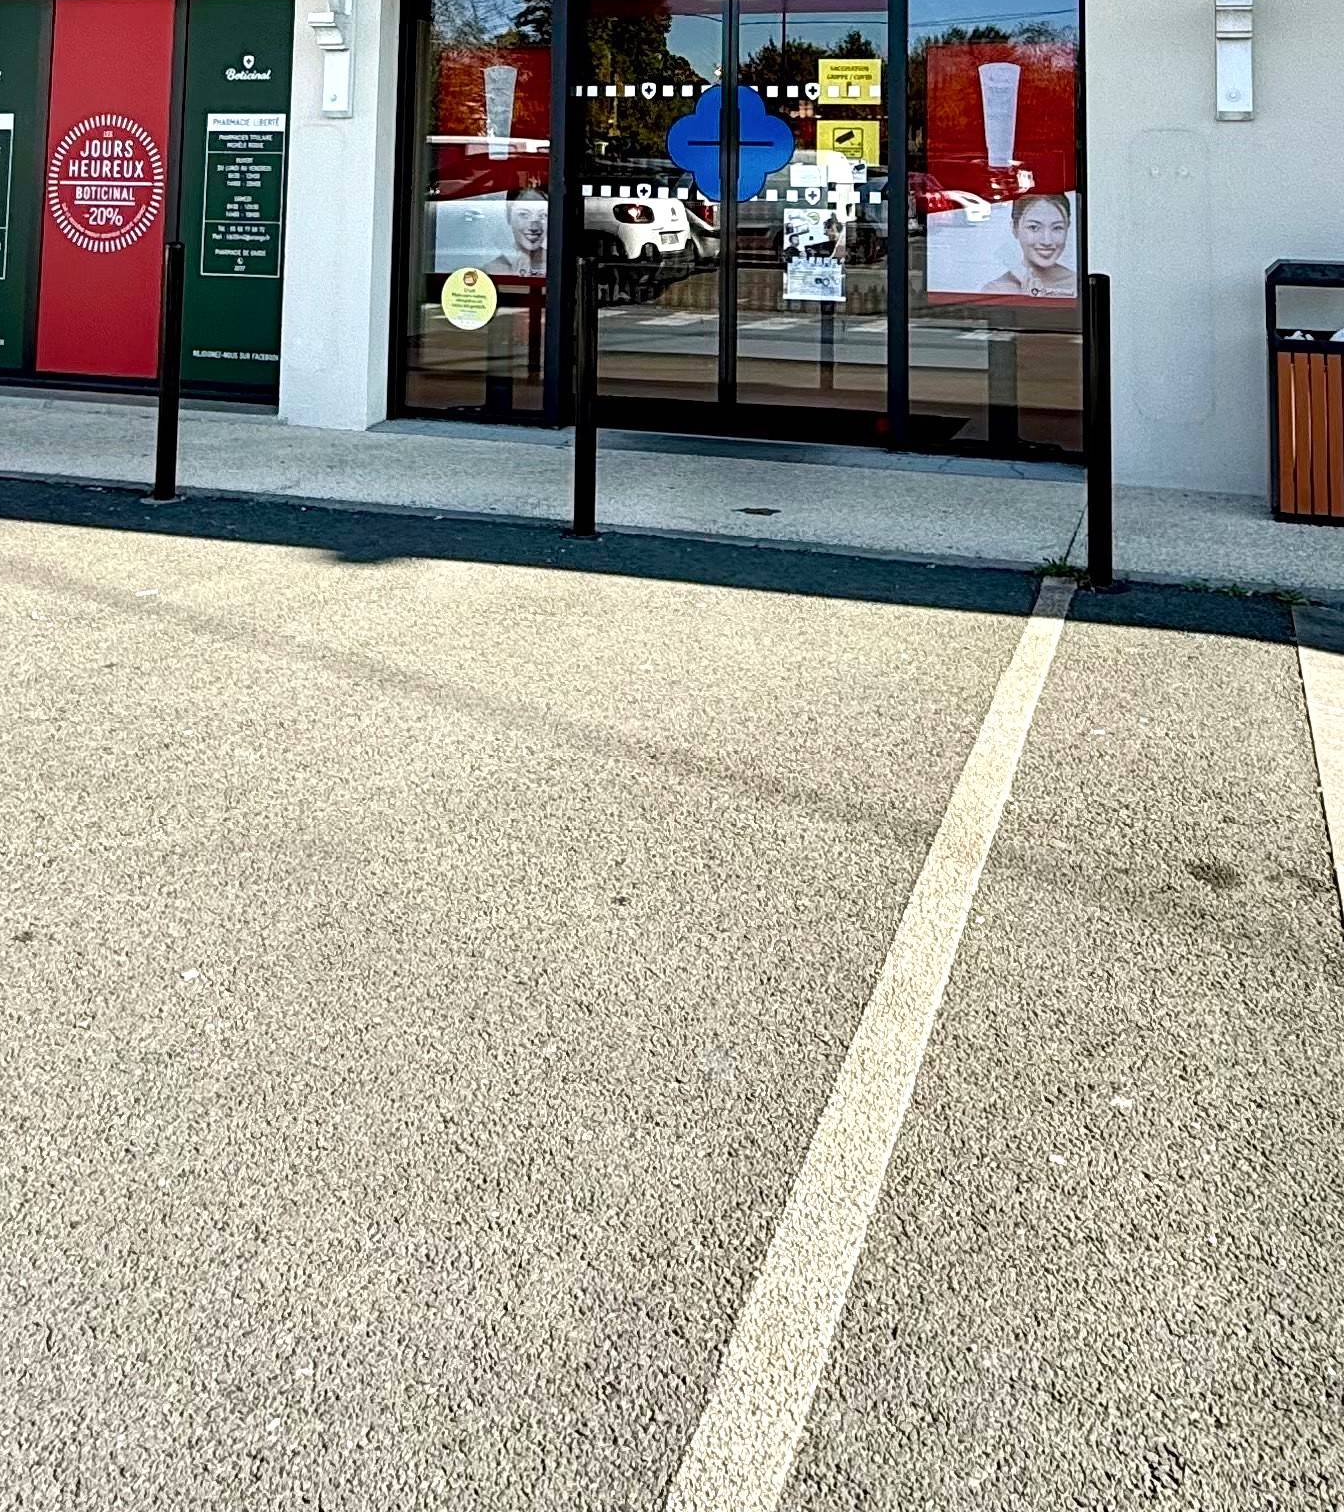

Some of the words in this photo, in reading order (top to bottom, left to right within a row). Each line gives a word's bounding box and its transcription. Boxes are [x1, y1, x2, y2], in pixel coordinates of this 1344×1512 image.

[225, 68, 272, 80] Boticinal
[213, 118, 250, 126] PHARMACIE
[80, 140, 134, 158] JOURS
[68, 159, 144, 178] HEUREUX
[76, 186, 135, 200] BOTICINAL
[82, 207, 123, 226] -20%
